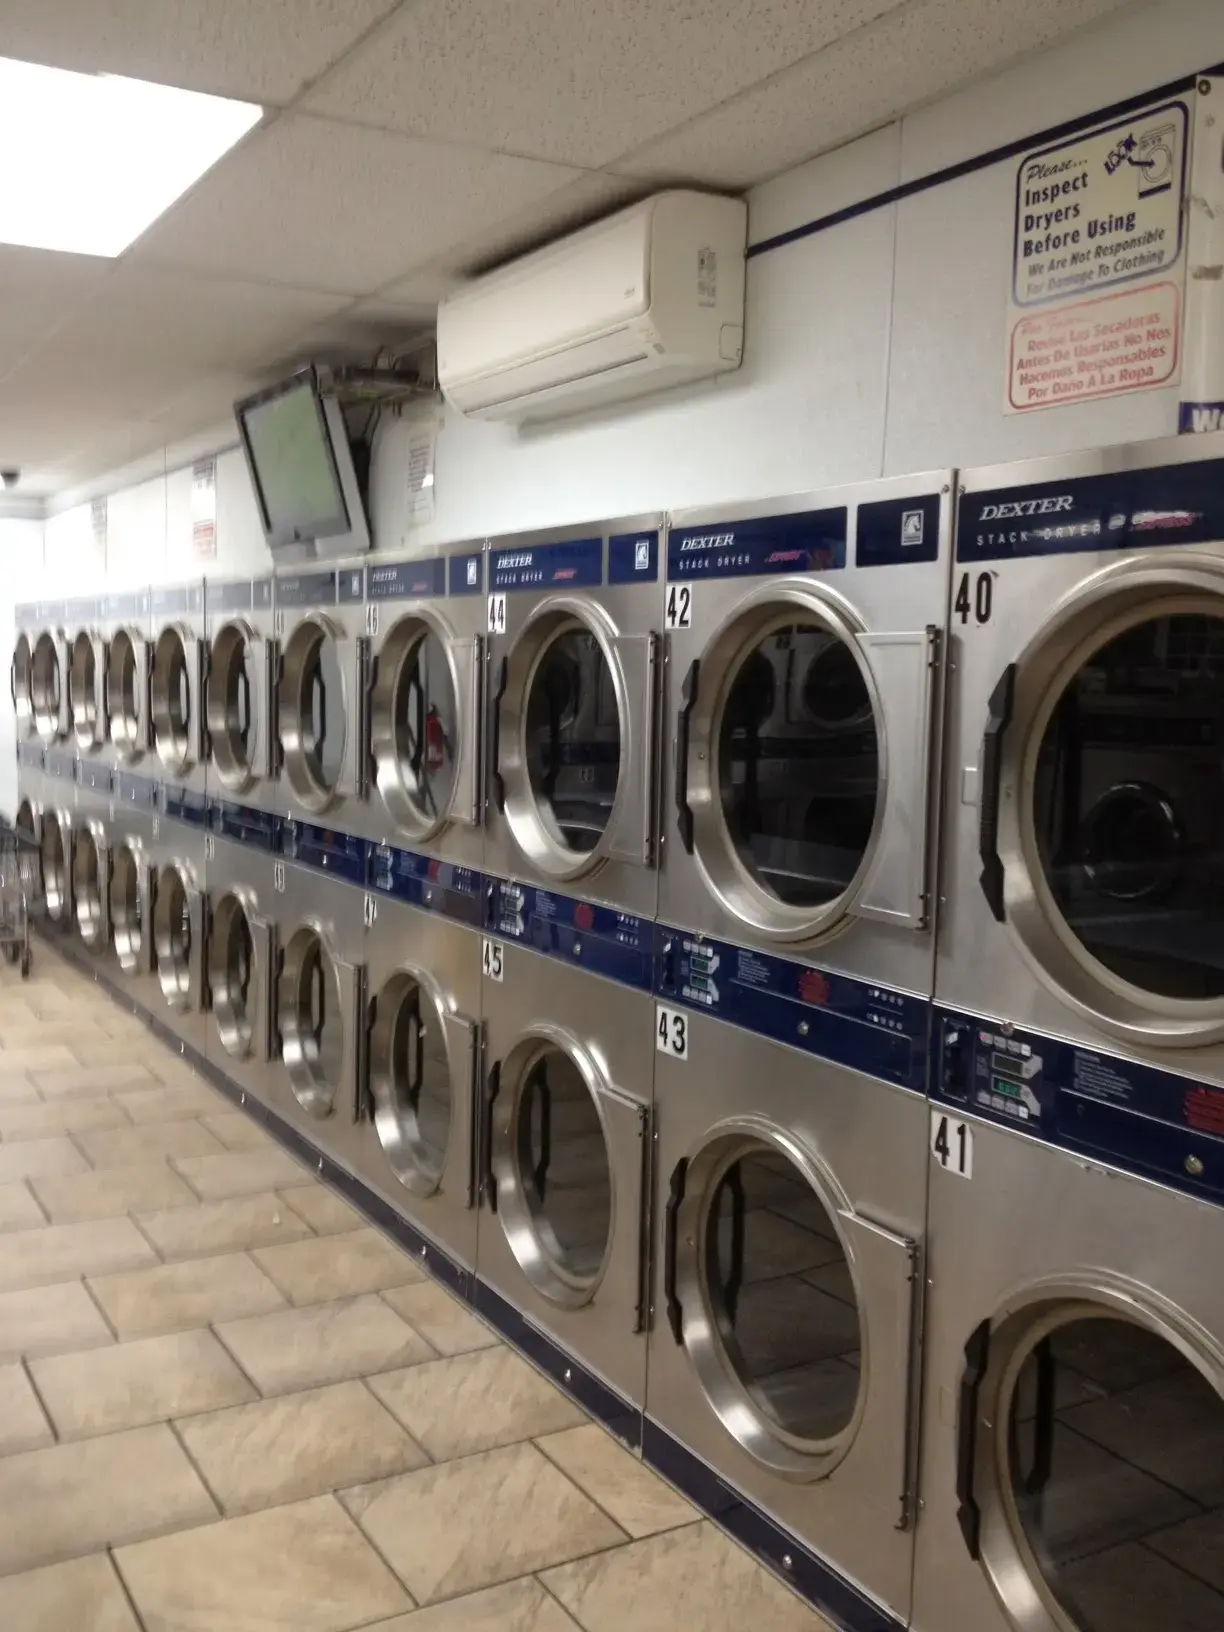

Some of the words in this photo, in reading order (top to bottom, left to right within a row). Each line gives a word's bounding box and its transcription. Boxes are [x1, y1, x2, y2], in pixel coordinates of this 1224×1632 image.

[1103, 132, 1138, 176] LOOK
[1025, 172, 1089, 207] Inspect
[1023, 228, 1080, 258] Before
[1087, 212, 1137, 238] Using
[1024, 203, 1081, 232] Dryers
[1028, 262, 1044, 277] We
[1047, 256, 1068, 272] Are
[1069, 249, 1091, 267] Not
[1094, 228, 1166, 258] Responsible
[1097, 263, 1110, 277] To
[1113, 250, 1166, 273] Clothing
[1017, 355, 1050, 371] Antes
[1053, 349, 1070, 363] De
[1146, 326, 1172, 341] Nos
[1028, 386, 1048, 400] Por
[1087, 375, 1096, 388] A
[1100, 372, 1115, 385] La
[1119, 365, 1154, 384] Ropa
[979, 495, 1075, 521] DEXTER
[681, 532, 735, 550] DEXTER
[976, 531, 1029, 546] STACK
[1043, 521, 1101, 541] DRYER
[496, 553, 532, 569] DEXTER
[679, 557, 709, 571] STACK
[717, 554, 750, 567] DRYER
[489, 595, 504, 631] 44
[667, 586, 690, 627] 42
[955, 571, 992, 624] 40
[485, 943, 502, 975] 45
[658, 1012, 686, 1054] 43
[934, 1116, 967, 1173] 41
